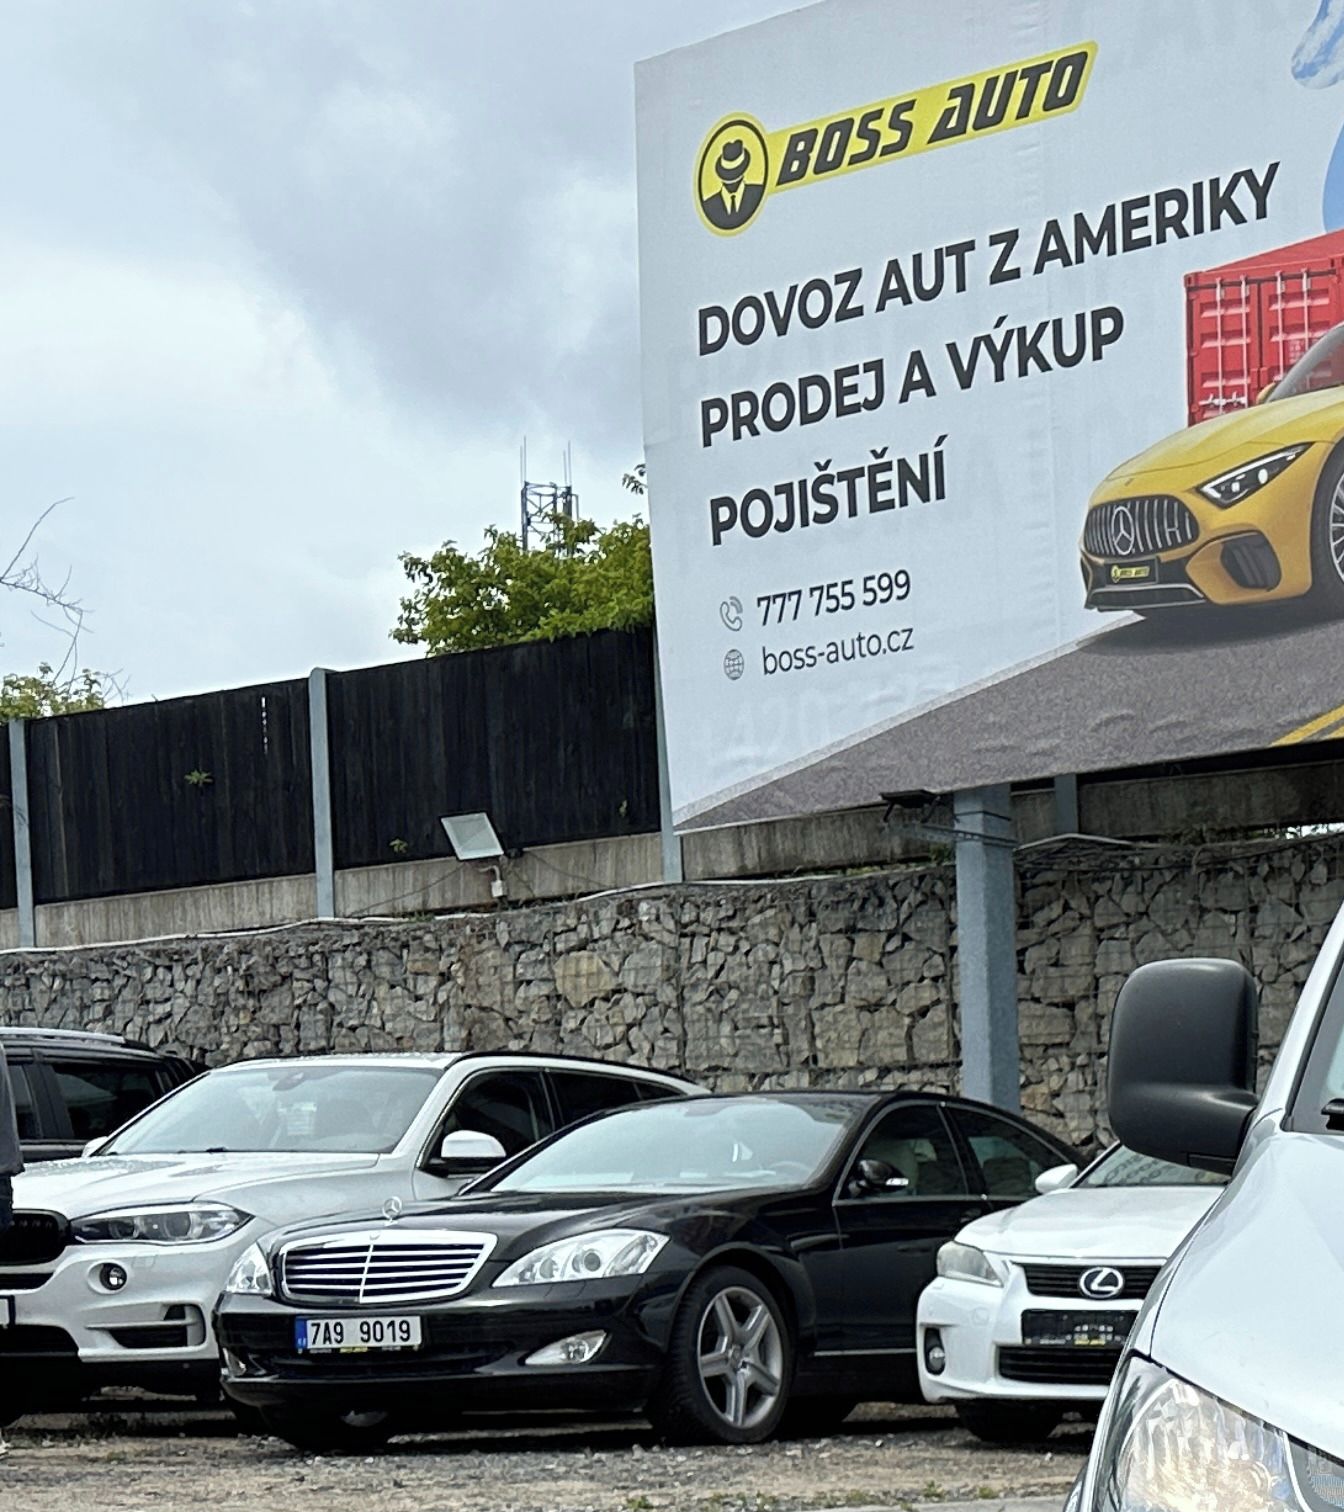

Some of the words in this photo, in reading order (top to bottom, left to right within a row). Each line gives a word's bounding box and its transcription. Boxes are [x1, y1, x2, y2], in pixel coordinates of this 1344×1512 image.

[776, 99, 915, 188] BOSS
[929, 51, 1089, 142] AUTO
[699, 269, 864, 356] DOVOZ
[875, 239, 977, 312] AUT
[988, 228, 1023, 285] Z
[1033, 161, 1281, 276] AMERIKY
[700, 364, 884, 448] PRODEJ
[899, 351, 938, 404] A
[946, 306, 1124, 391] VÝKUP
[709, 436, 948, 546] POJIŠTĚNÍ
[756, 590, 801, 628] 777
[809, 580, 856, 619] 755
[862, 570, 911, 611] 599
[761, 629, 914, 676] boss-auto.cz
[311, 1322, 344, 1345] 7A9
[360, 1320, 410, 1342] 9019
